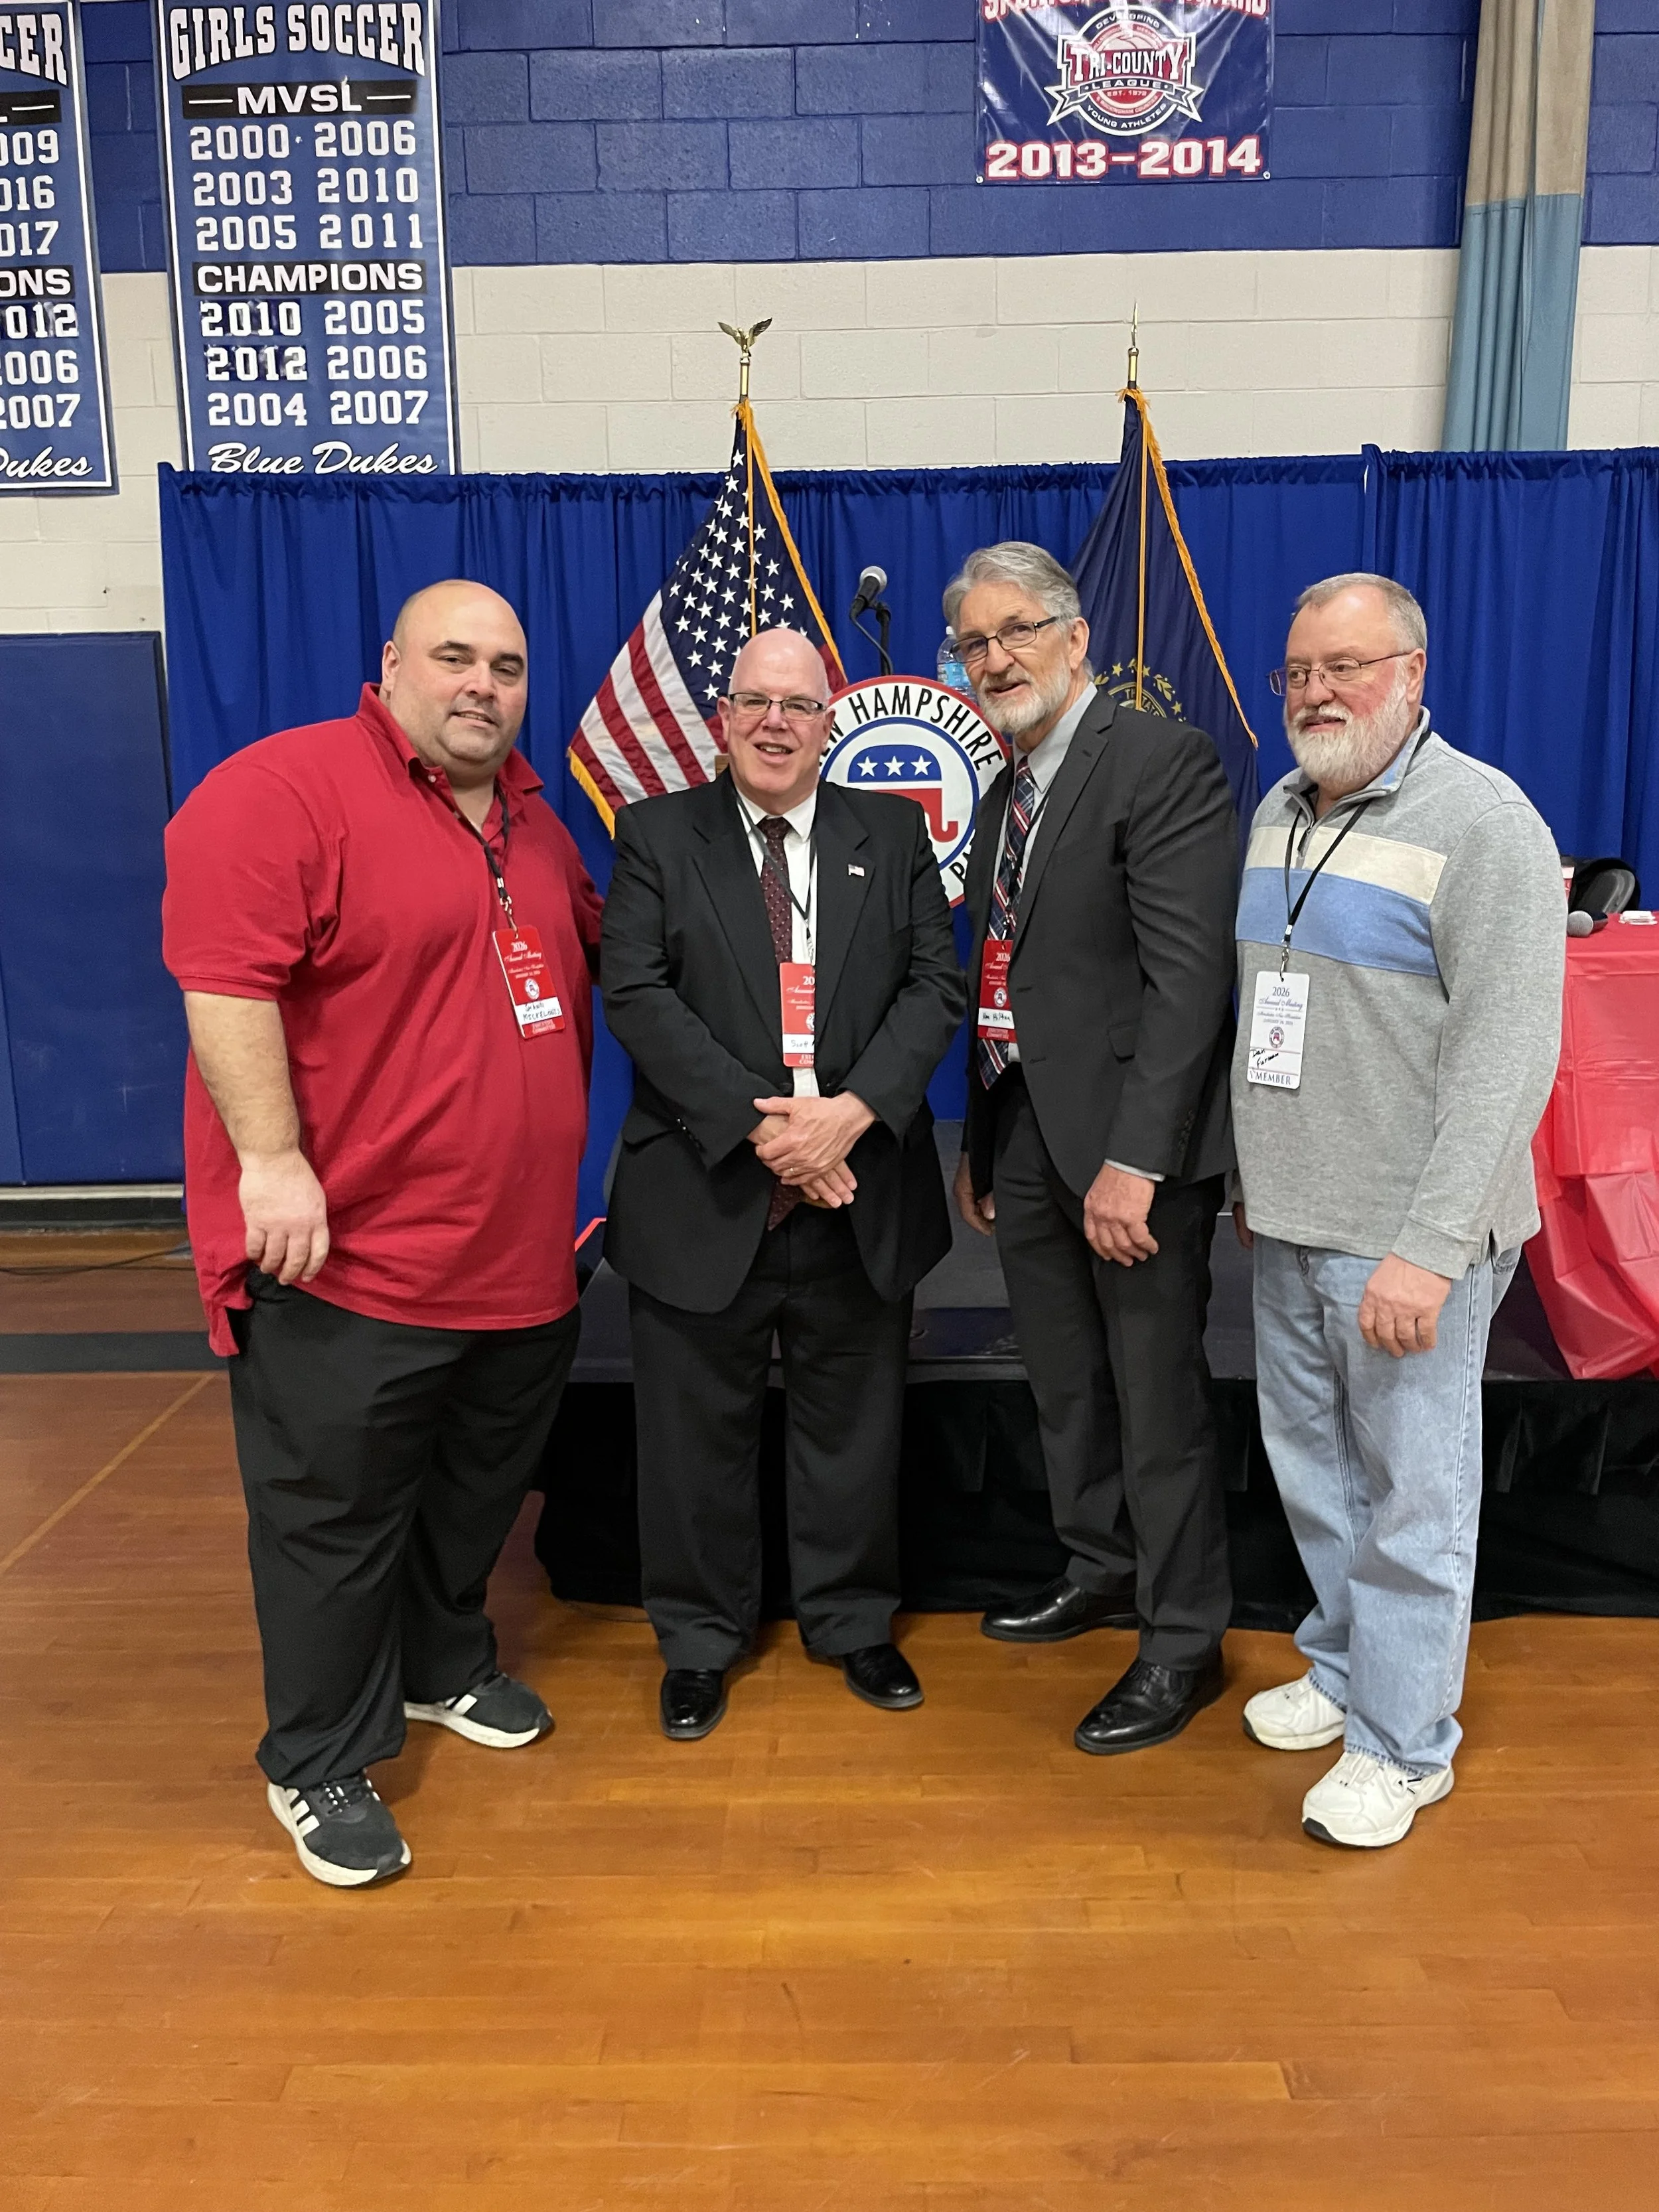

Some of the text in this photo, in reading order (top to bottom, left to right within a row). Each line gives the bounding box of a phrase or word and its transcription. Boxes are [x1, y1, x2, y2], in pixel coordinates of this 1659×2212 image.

[171, 2, 426, 80] GIRLS SOCCER
[1070, 43, 1184, 82] TRI-COUNTY
[238, 84, 362, 115] MVSL
[1092, 79, 1161, 90] LEAGUE
[1087, 103, 1167, 129] YOUNG ATHLETES
[190, 120, 416, 160] 2000 2006
[986, 137, 1262, 179] 2013-2014
[193, 167, 419, 206] 2003 2010
[196, 213, 423, 252] 2005 2011
[198, 262, 423, 293] CHAMPIONS
[201, 299, 427, 337] 2010 2005
[206, 344, 427, 382] 2012 2006
[208, 390, 429, 427] 2004 2007
[208, 440, 438, 475] Blue Dukes
[848, 686, 1003, 771] HAMPSHIRE
[1272, 986, 1290, 997] 2026
